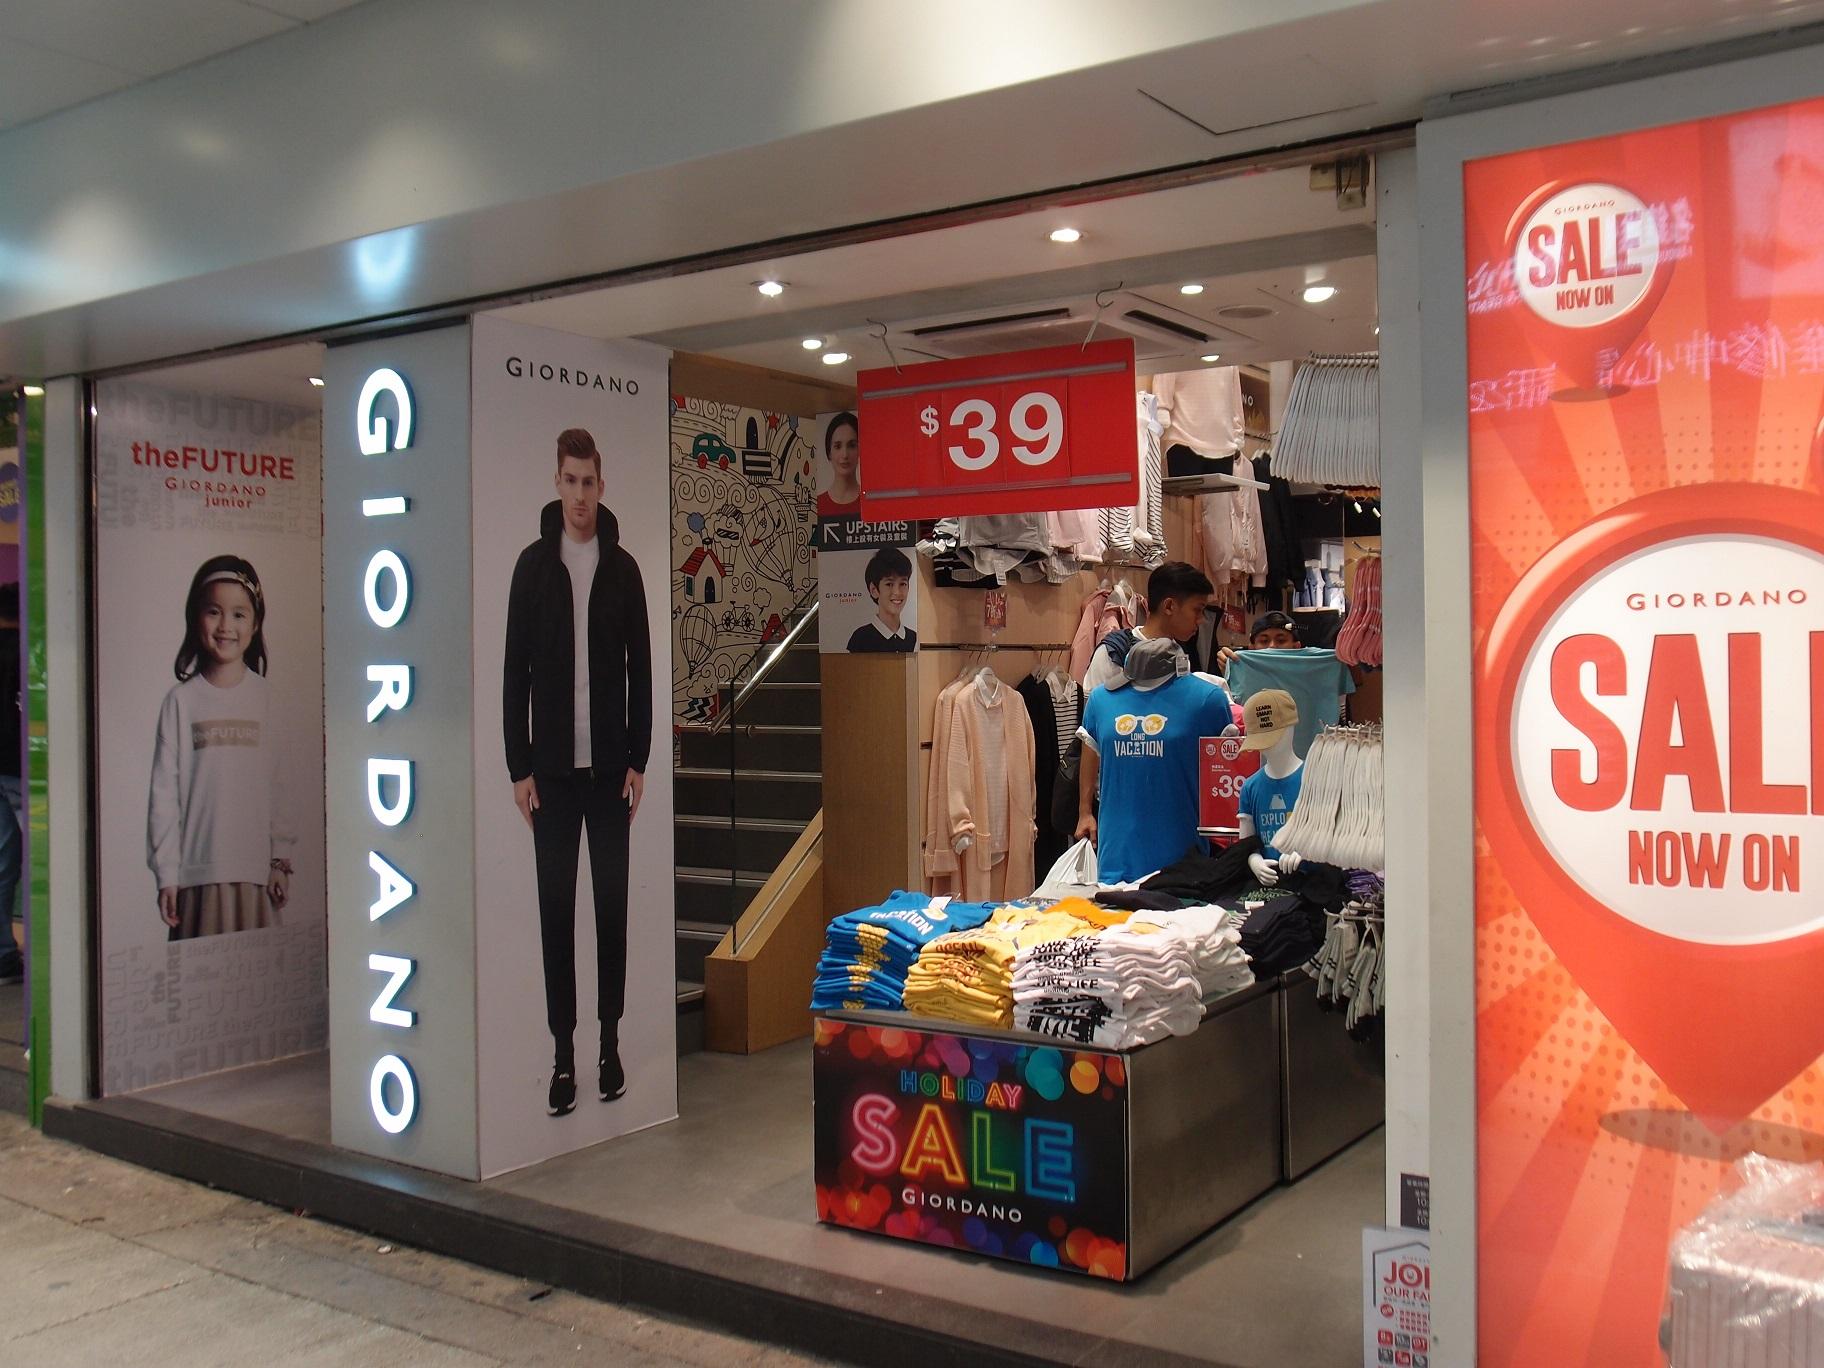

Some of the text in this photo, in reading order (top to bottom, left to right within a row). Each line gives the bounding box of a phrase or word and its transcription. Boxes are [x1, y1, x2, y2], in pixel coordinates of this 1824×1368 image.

[1555, 200, 1615, 214] GIORDANO
[1528, 211, 1643, 289] SALE
[1556, 284, 1614, 311] NOW ON
[506, 357, 639, 396] GIORDANO
[130, 441, 295, 480] theFUTURE
[164, 476, 267, 497] GIORDANO
[204, 494, 252, 510] junior
[846, 520, 908, 534] UPSTAIRS
[1626, 589, 1808, 611] GIORDANO
[1259, 721, 1274, 729] HARD
[1550, 630, 1824, 816] SAL
[356, 367, 417, 1135] GIORDANO
[1222, 744, 1238, 754] SALE
[1261, 811, 1286, 826] EXPLO
[1628, 830, 1800, 893] NOW ON
[167, 944, 182, 1025] FUTURE
[900, 1069, 1023, 1110] HOLIDAY
[852, 1093, 1075, 1202] SALE
[901, 1187, 1023, 1224] GIORDANO
[1383, 1260, 1430, 1290] JOI
[1383, 1286, 1409, 1299] OUR
[1411, 1289, 1430, 1303] FA
